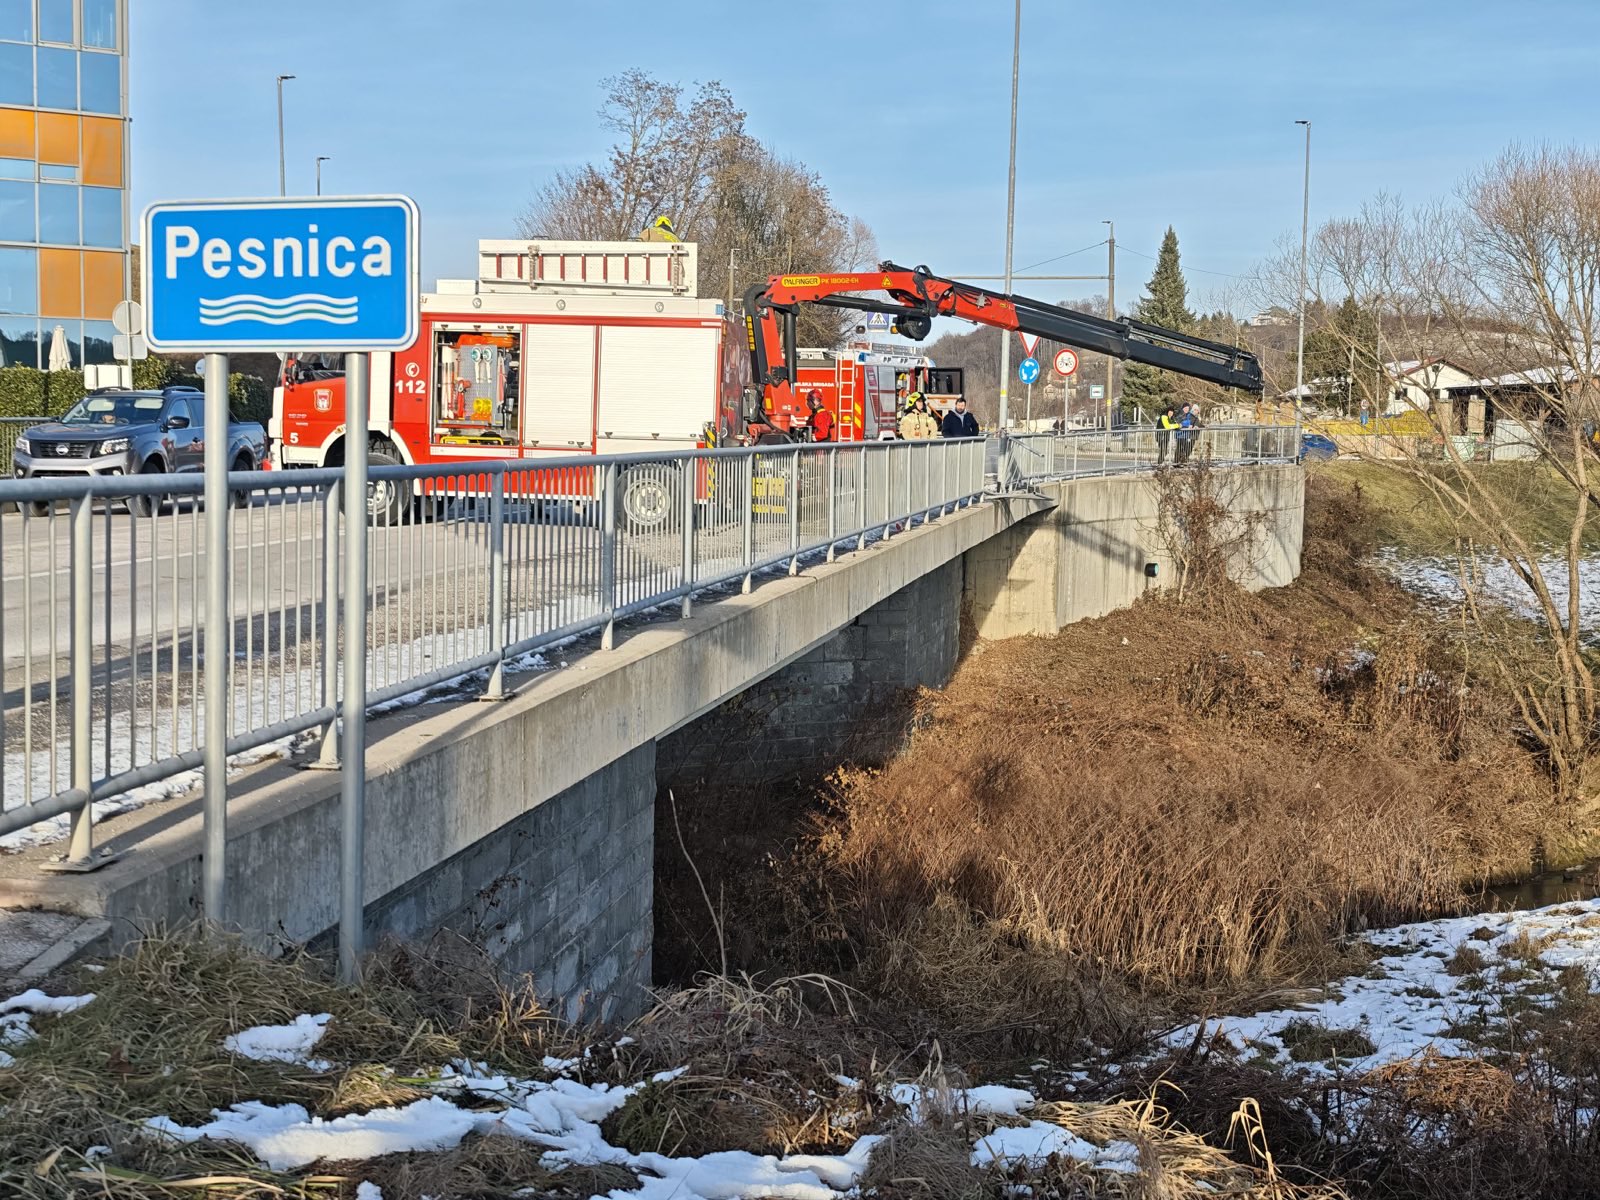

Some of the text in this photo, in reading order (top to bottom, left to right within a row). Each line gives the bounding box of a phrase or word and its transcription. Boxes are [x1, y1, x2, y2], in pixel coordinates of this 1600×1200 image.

[165, 223, 393, 280] Pesnica
[395, 379, 426, 394] 112
[290, 432, 299, 444] 5
